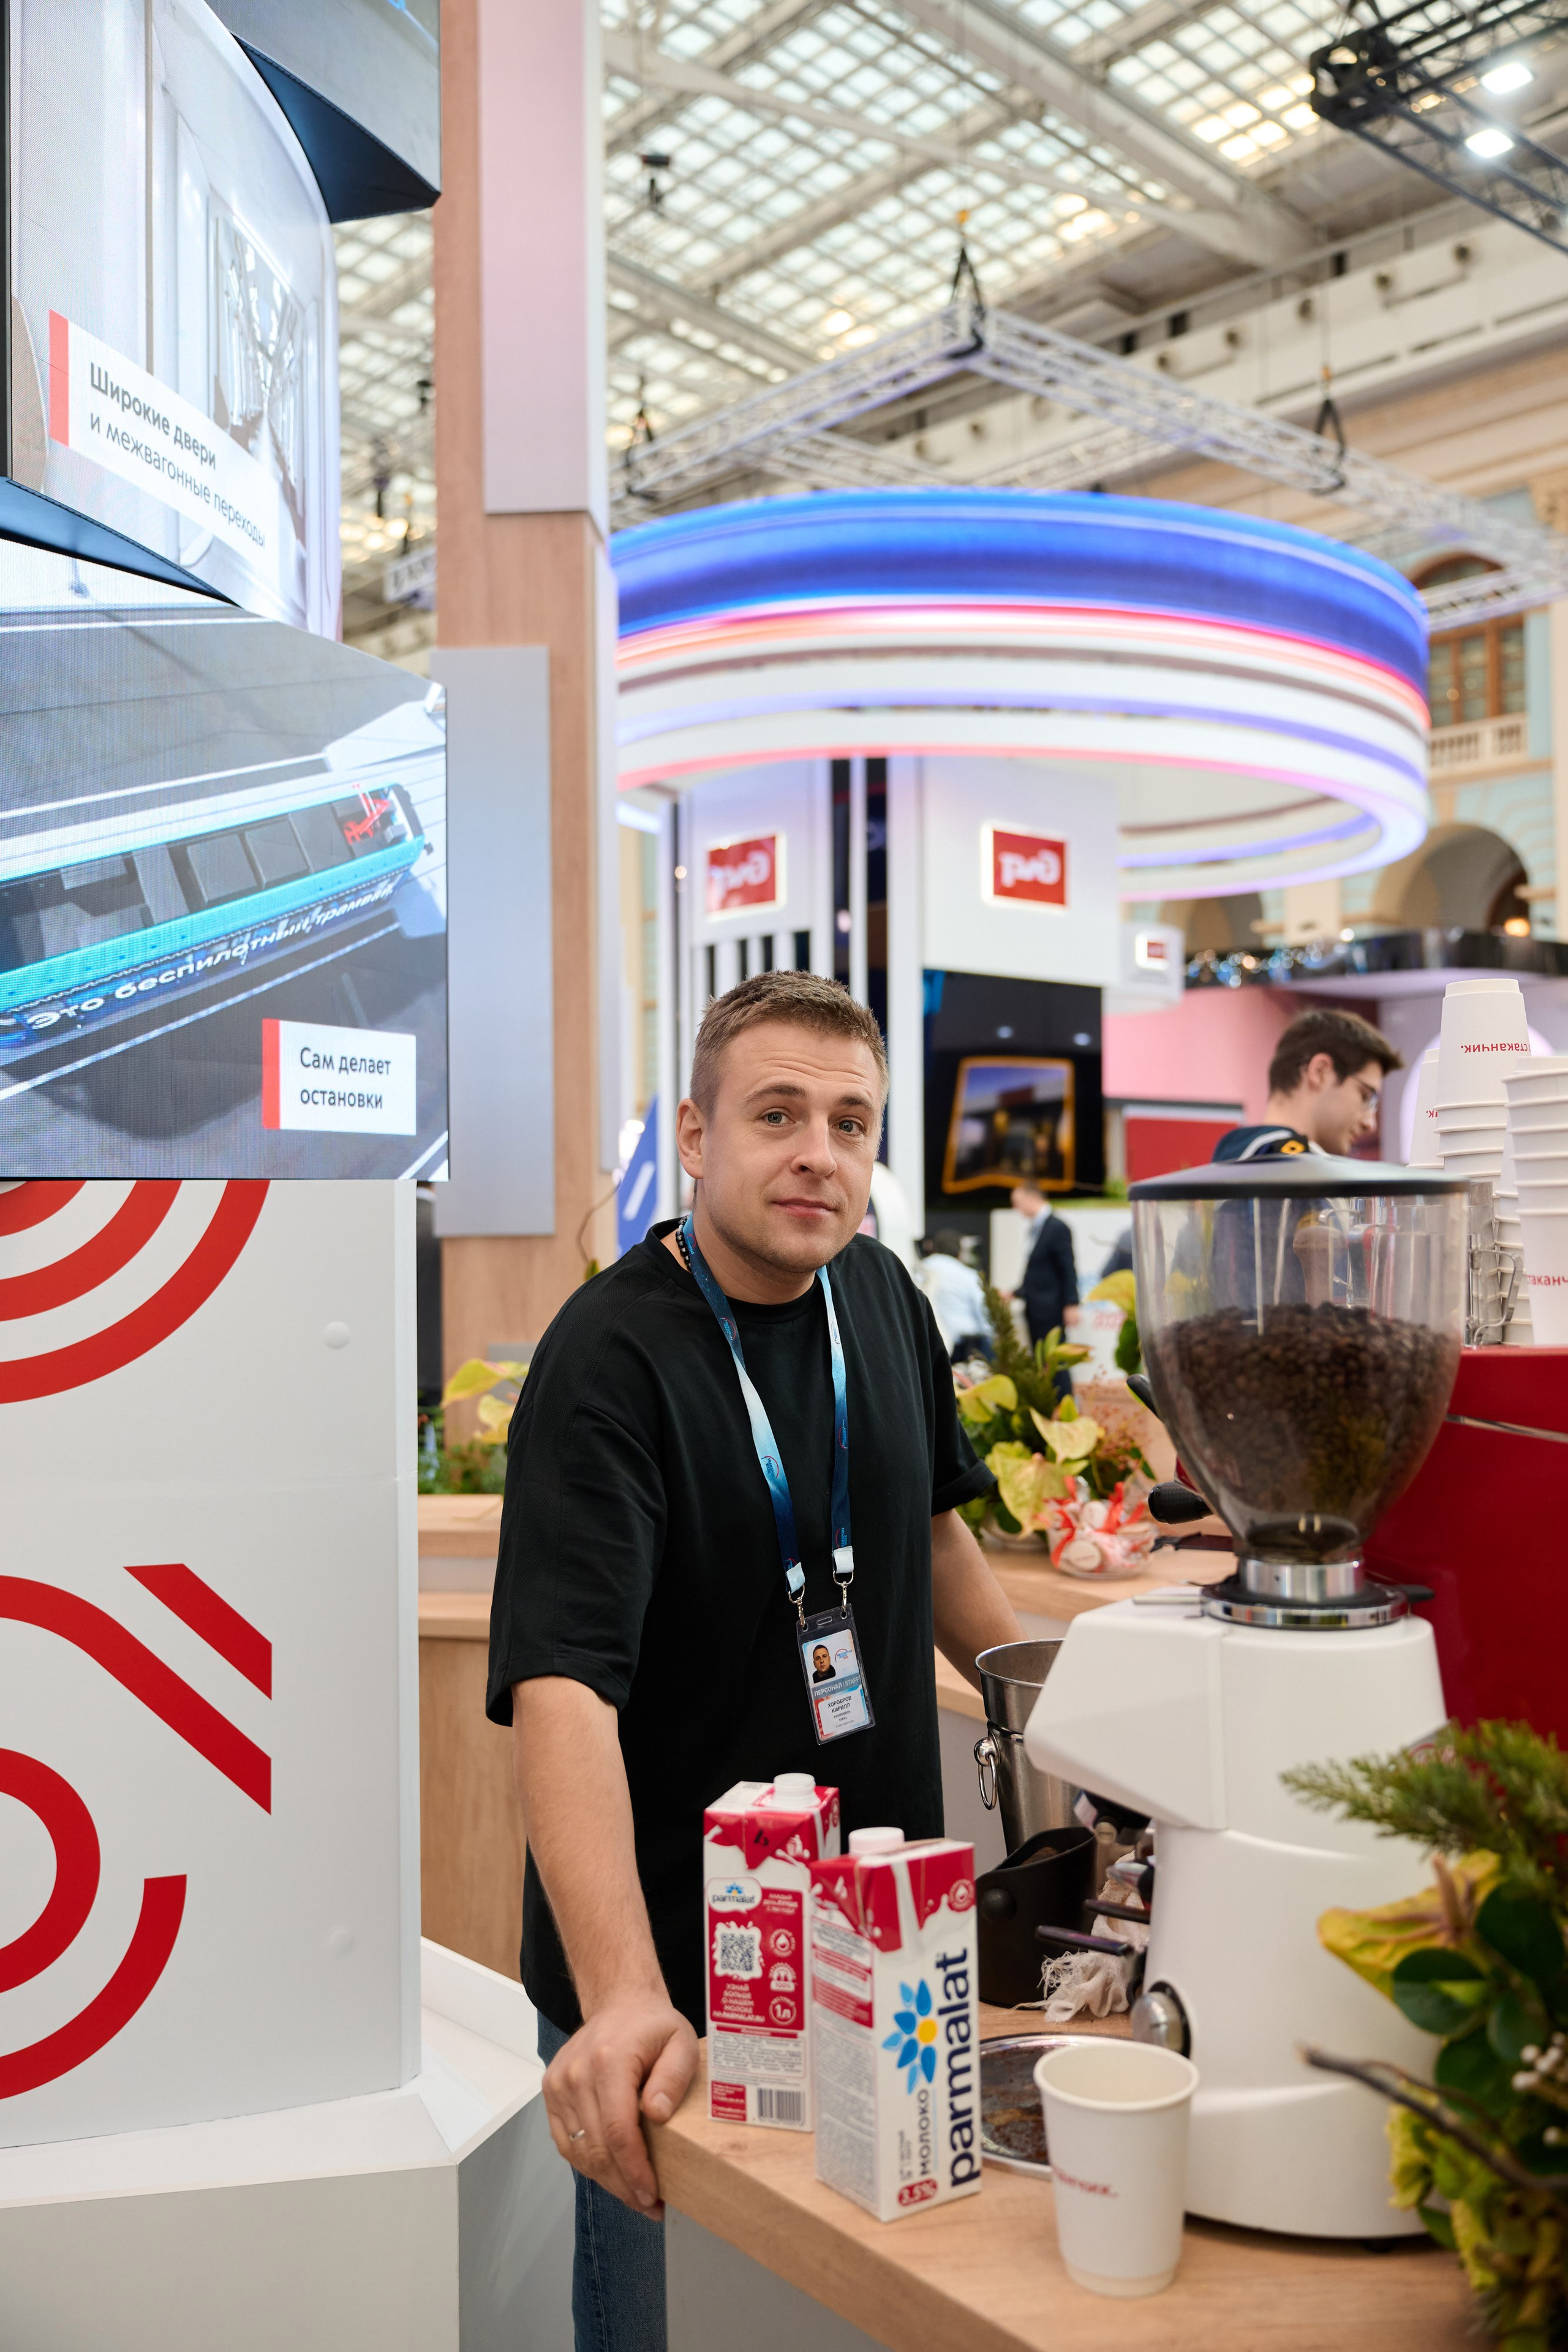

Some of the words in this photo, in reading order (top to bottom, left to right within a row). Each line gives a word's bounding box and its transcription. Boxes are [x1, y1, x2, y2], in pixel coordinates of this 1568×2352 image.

[91, 362, 170, 435] Широкие
[174, 424, 216, 470] двери
[90, 412, 100, 434] и
[106, 423, 211, 504] межвагонные
[214, 492, 265, 548] переходы
[26, 997, 104, 1030] Это
[300, 1047, 334, 1071] Сам
[339, 1055, 391, 1075] делает
[300, 1088, 383, 1109] остановки
[814, 1682, 843, 1697] ПЕРСОНАЛ
[845, 1676, 859, 1686] STAFF
[827, 1695, 852, 1708] ХОРОБРОВ
[831, 1703, 851, 1713] КИРИЛЛ
[712, 1893, 755, 1904] parmalat
[935, 1947, 981, 2187] parmalat
